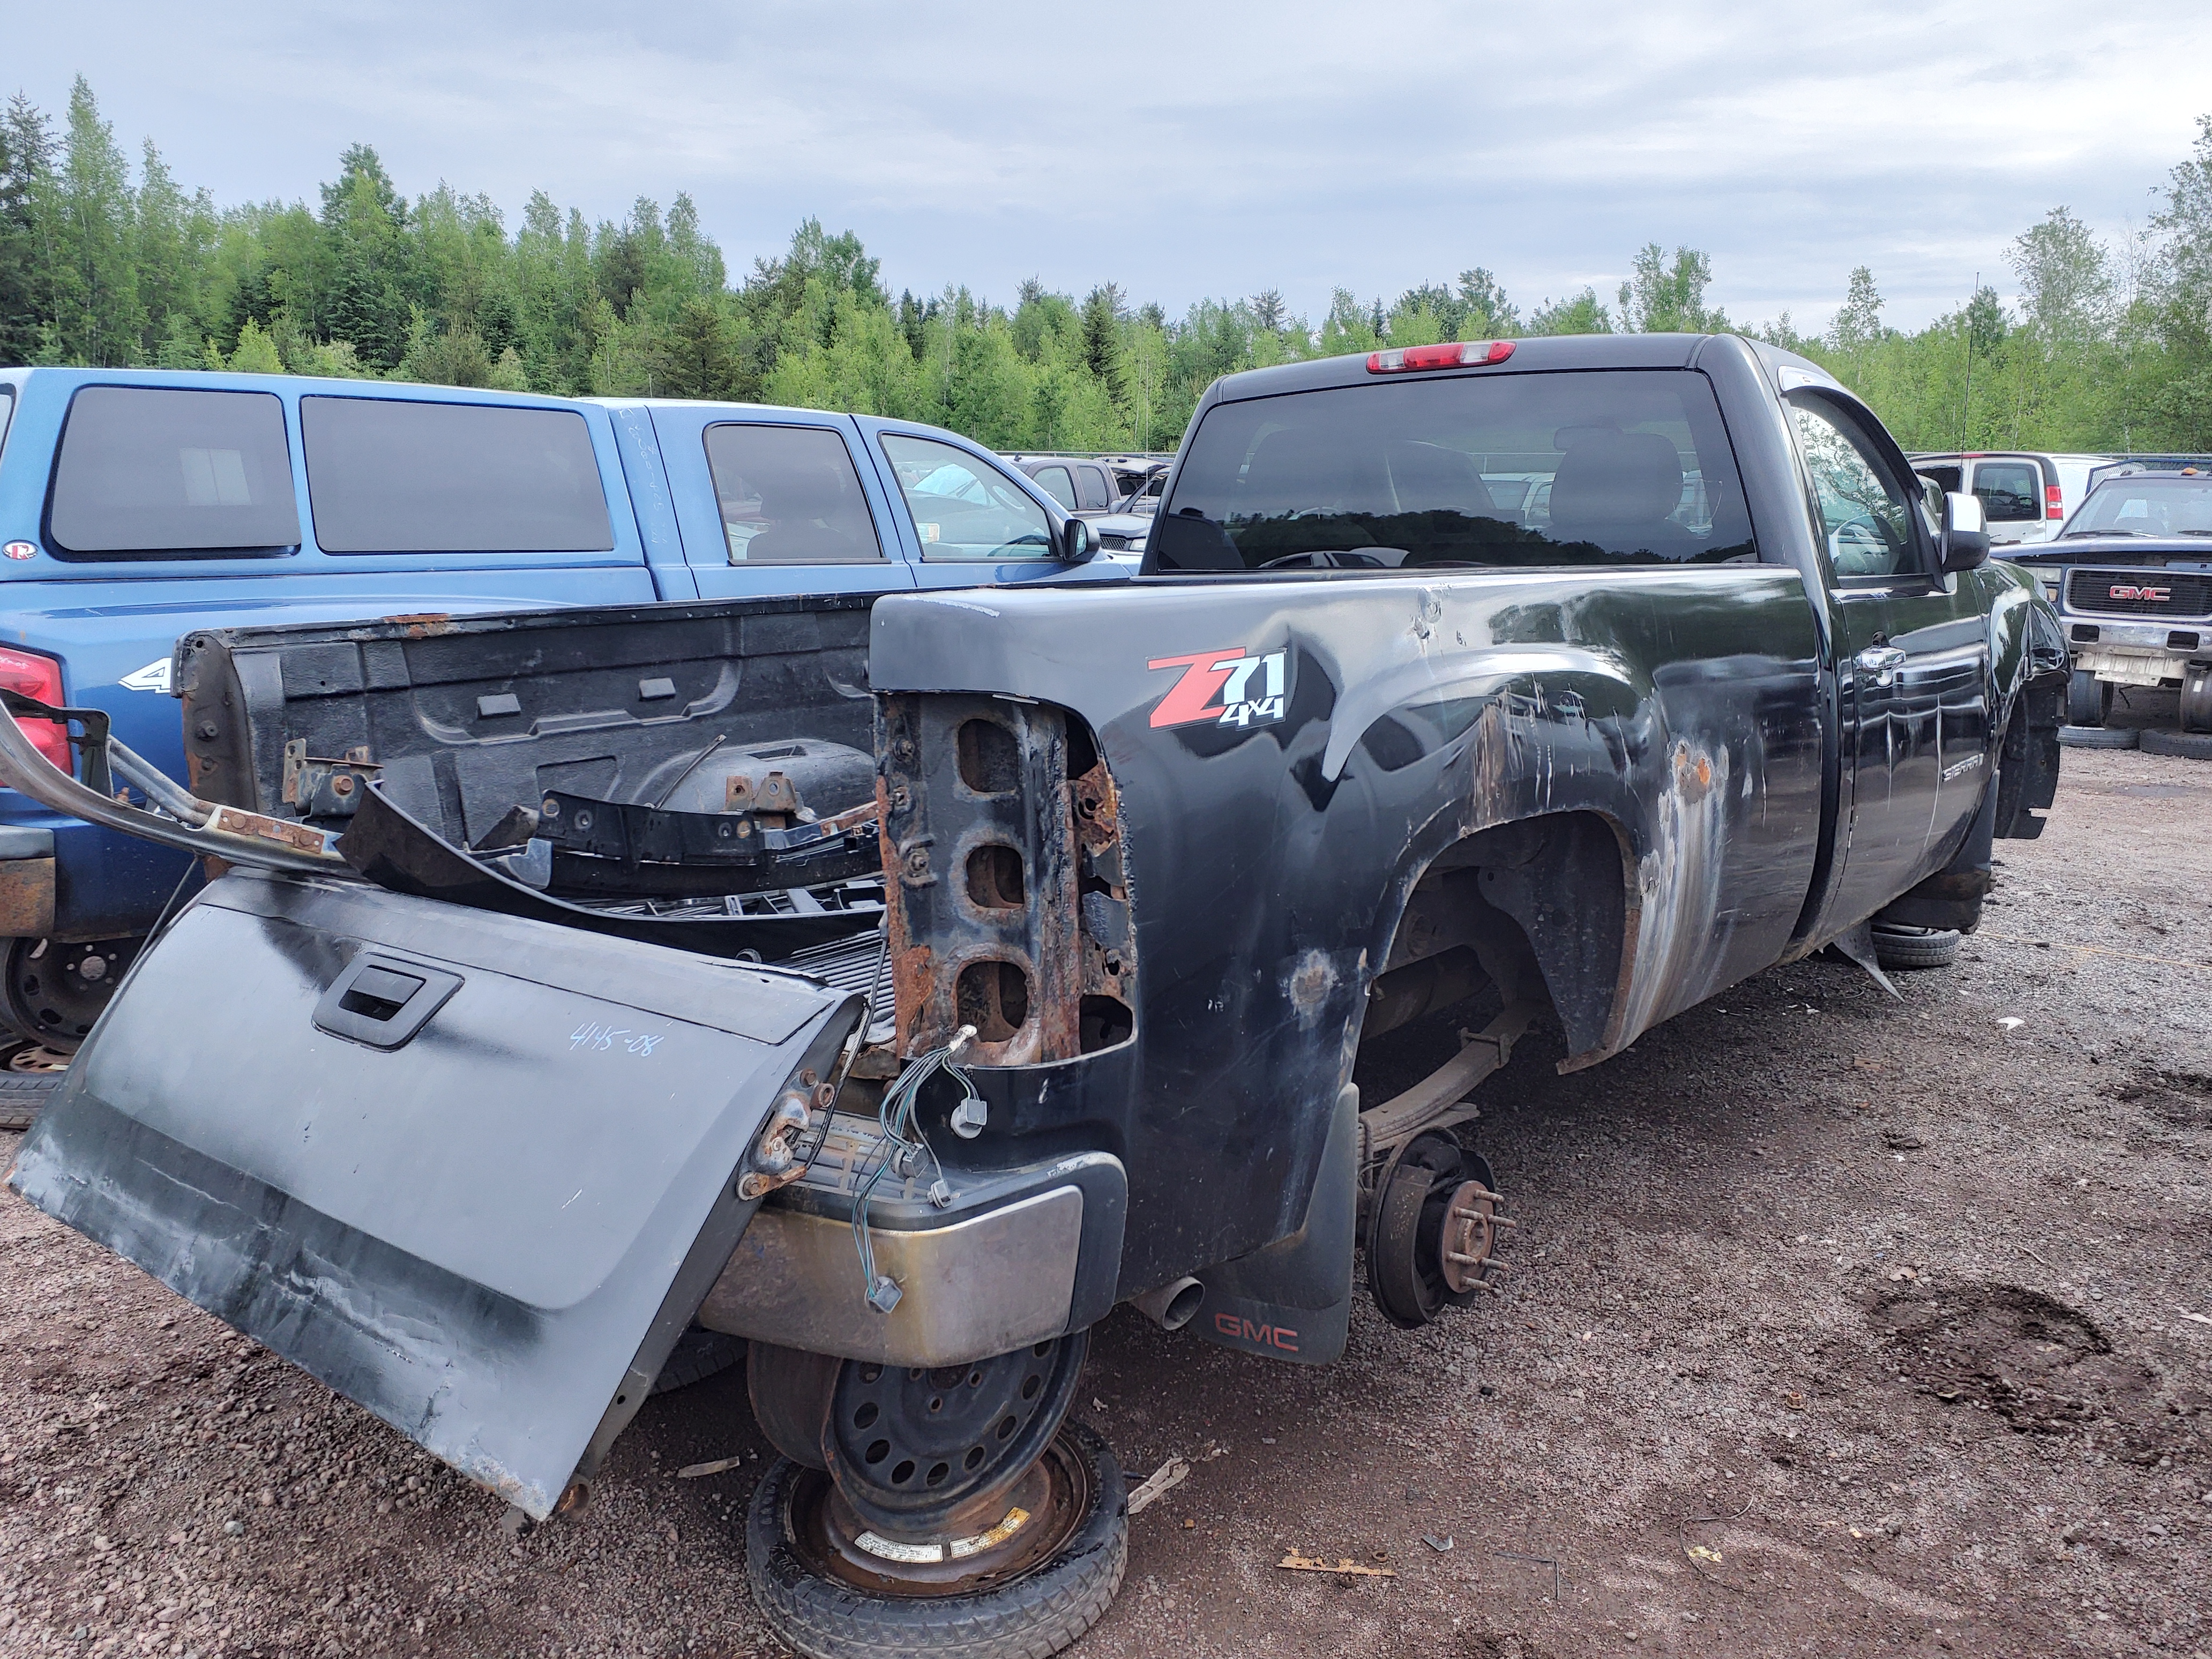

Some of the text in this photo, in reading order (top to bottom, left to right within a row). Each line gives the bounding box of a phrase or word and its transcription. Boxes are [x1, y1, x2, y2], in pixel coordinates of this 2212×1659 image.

[2110, 586, 2171, 601] GMC
[1147, 647, 1285, 728] Z71
[1215, 1313, 1299, 1352] GMC
